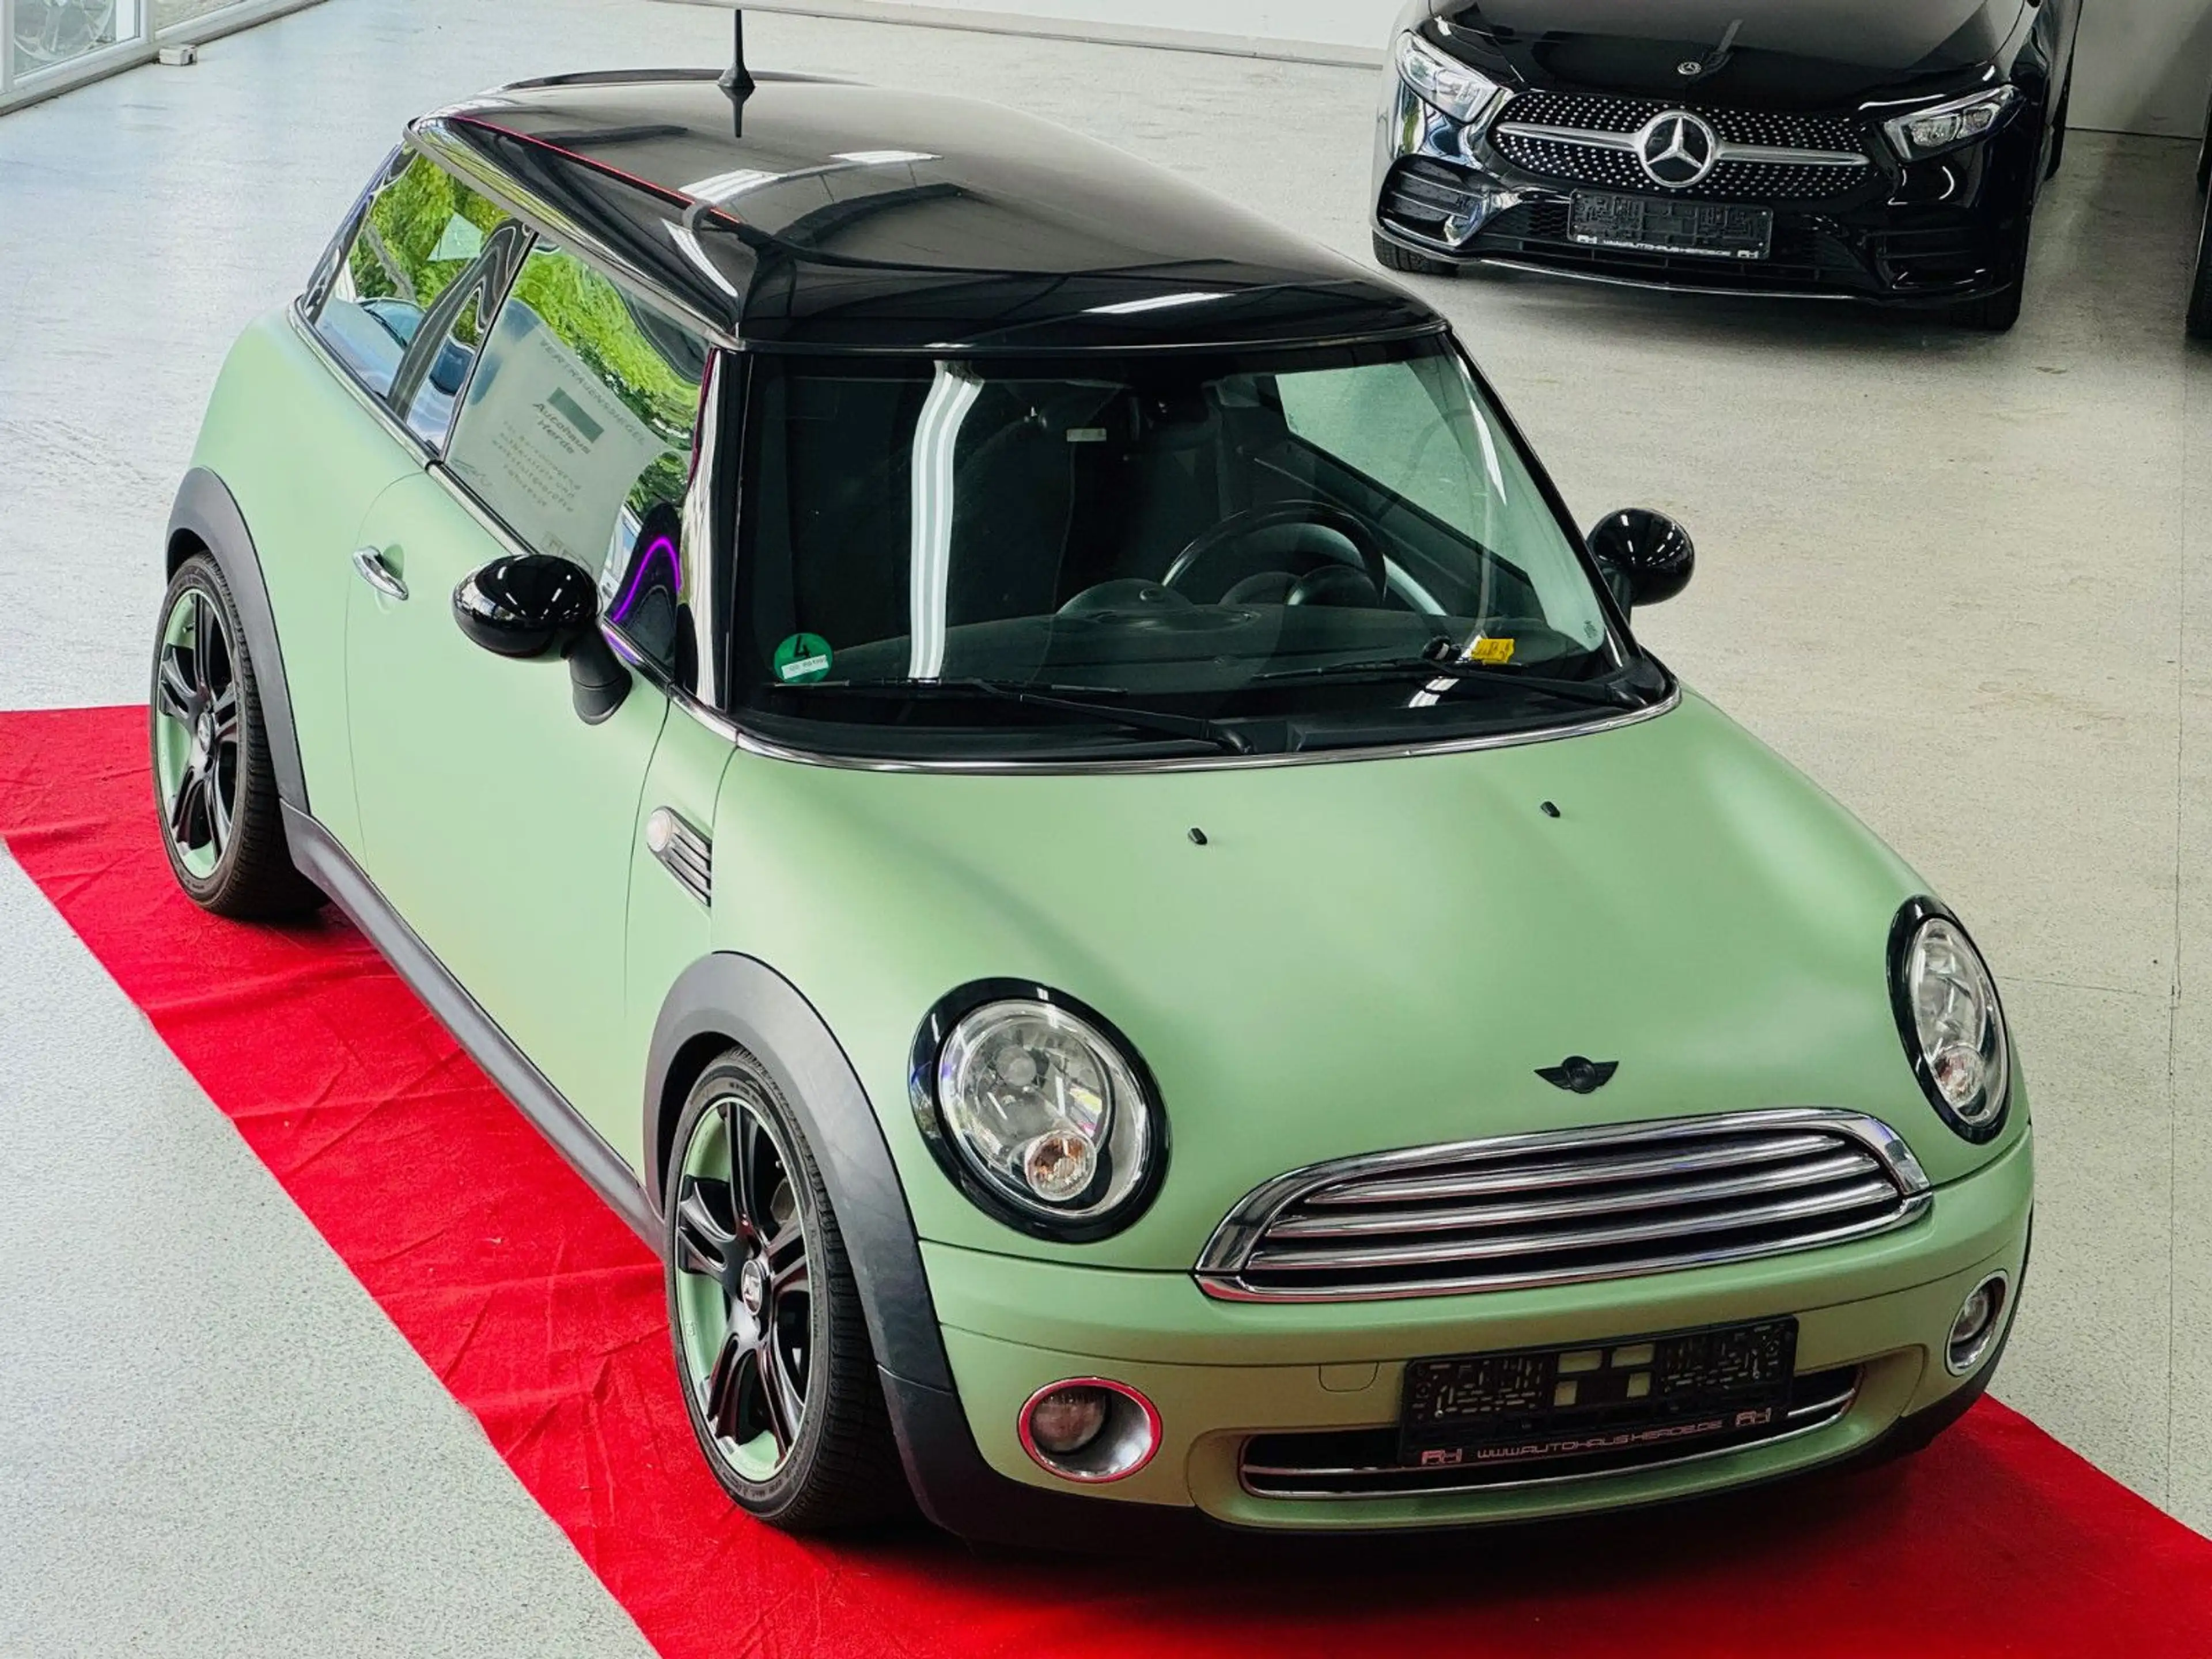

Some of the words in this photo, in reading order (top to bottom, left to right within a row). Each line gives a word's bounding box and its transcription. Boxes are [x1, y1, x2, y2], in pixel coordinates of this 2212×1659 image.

[532, 403, 591, 454] Autohaus
[537, 419, 575, 454] Herde
[793, 634, 811, 658] 4
